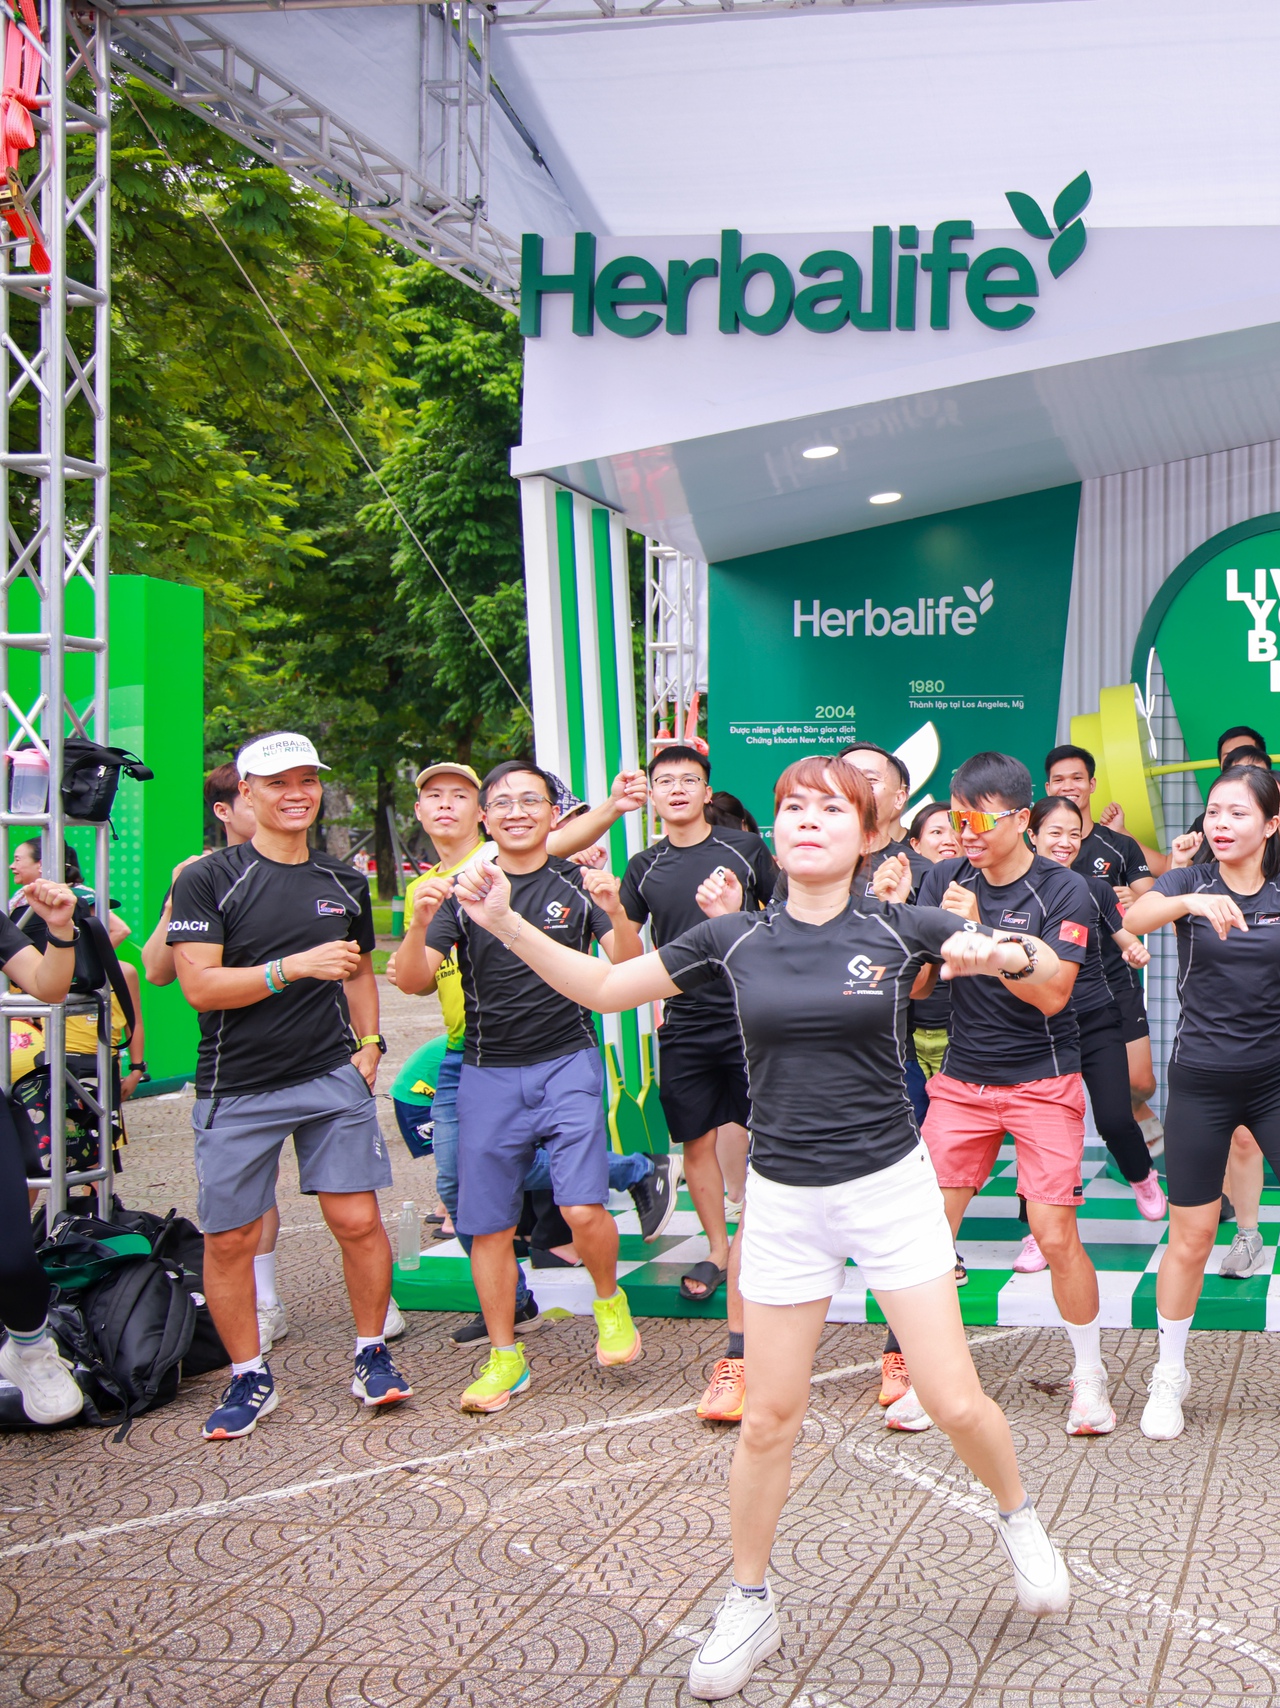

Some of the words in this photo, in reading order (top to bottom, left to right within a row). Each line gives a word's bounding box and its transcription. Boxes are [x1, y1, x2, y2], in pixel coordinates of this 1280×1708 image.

[519, 219, 1039, 338] Herbalife
[793, 596, 978, 638] Herbalife
[908, 680, 945, 693] 1980
[908, 700, 934, 709] Thành
[935, 700, 948, 710] lập
[949, 700, 961, 710] tại
[962, 700, 976, 708] Los
[977, 700, 1010, 710] Angeles,
[1011, 700, 1024, 710] Mỹ
[814, 705, 856, 719] 2004
[729, 726, 750, 735] Được
[751, 726, 771, 734] niêm
[772, 724, 785, 736] yết
[786, 725, 802, 734] trên
[803, 725, 819, 734] Sàn
[820, 726, 838, 735] giao
[838, 725, 856, 735] dịch
[745, 735, 773, 746] Chứng
[773, 735, 798, 744] khoán
[799, 735, 816, 744] New
[817, 735, 835, 744] York
[836, 735, 856, 744] NYSE
[167, 920, 210, 932] COACH
